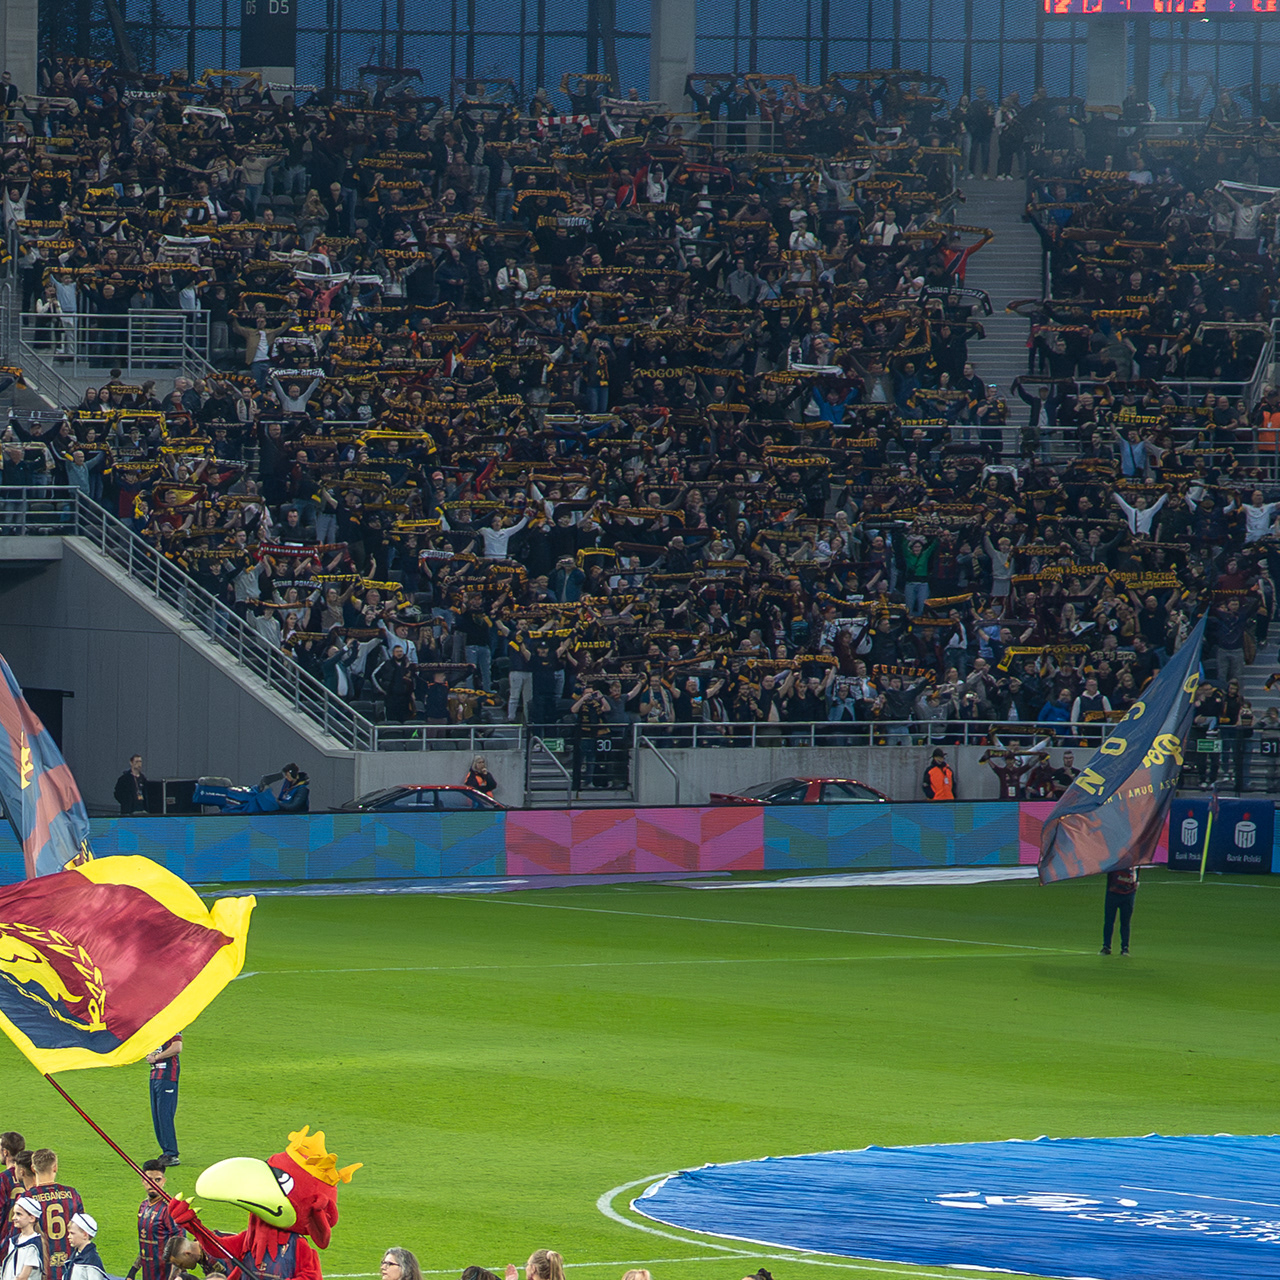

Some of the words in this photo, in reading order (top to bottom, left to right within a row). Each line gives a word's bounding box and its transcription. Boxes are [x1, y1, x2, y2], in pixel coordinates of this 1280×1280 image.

[596, 740, 612, 752] 30
[1263, 742, 1278, 752] 31
[46, 1203, 66, 1240] 6
